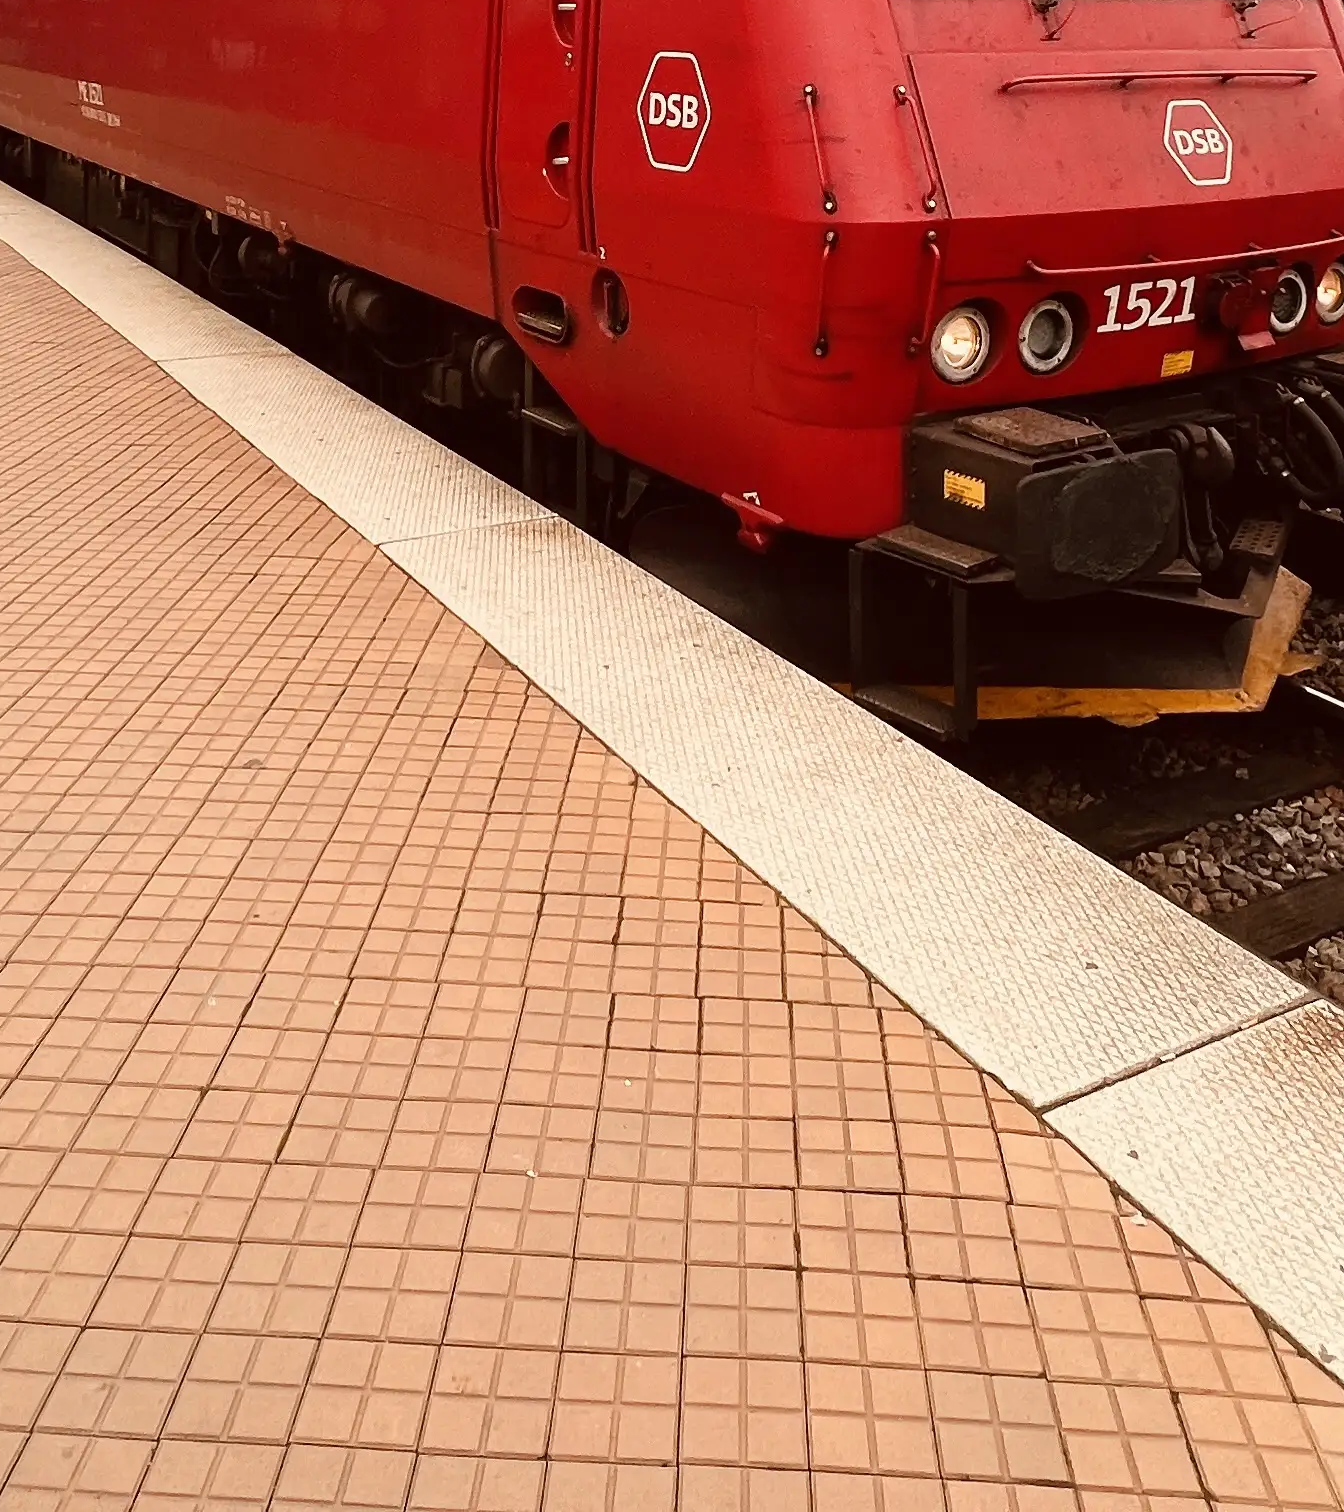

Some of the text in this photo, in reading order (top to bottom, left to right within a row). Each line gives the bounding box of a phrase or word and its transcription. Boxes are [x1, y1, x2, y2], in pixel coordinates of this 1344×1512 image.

[648, 91, 699, 130] DSB
[1173, 126, 1225, 156] DSB
[1096, 276, 1196, 334] 1521
